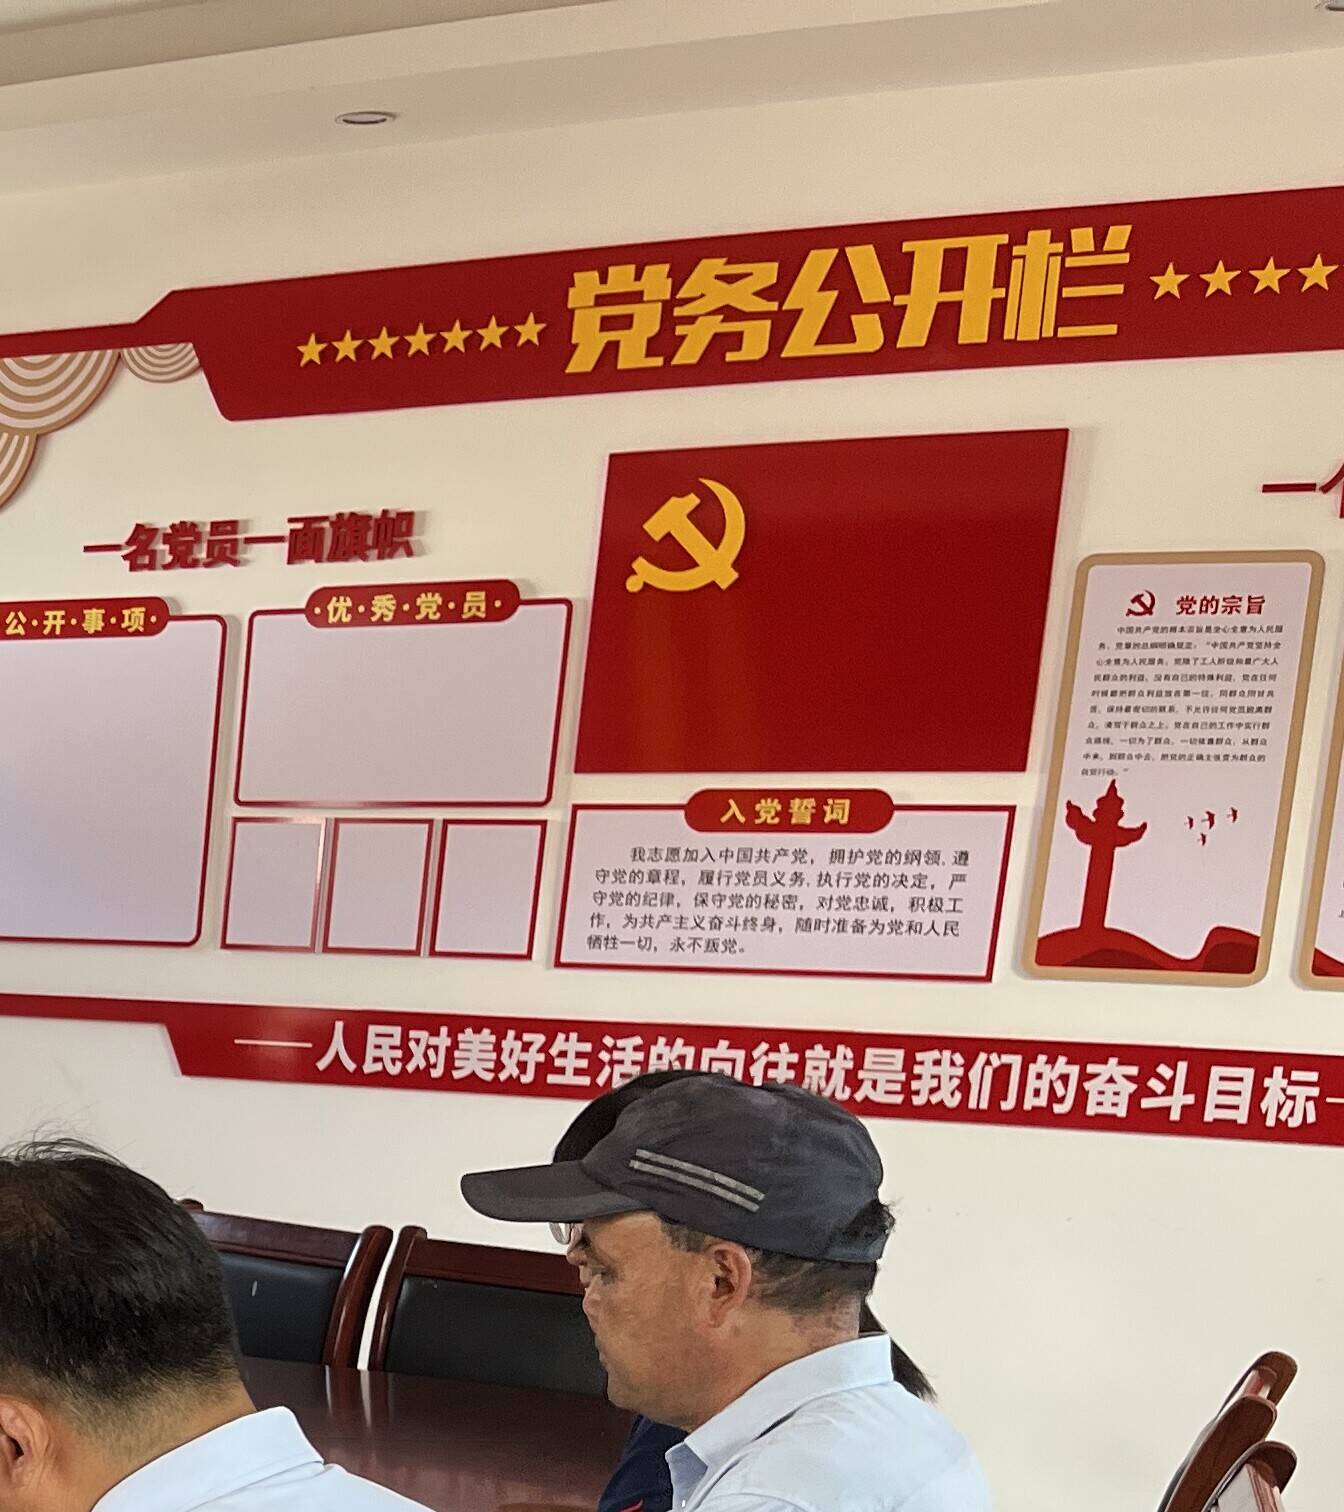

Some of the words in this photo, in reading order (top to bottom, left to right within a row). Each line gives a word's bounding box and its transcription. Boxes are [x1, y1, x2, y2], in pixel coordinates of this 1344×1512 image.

[563, 222, 1135, 375] 党务公开栏
[83, 510, 416, 572] 一名党员一面旗帜
[1176, 594, 1266, 616] 党的宗旨
[719, 797, 852, 826] 入党誓词
